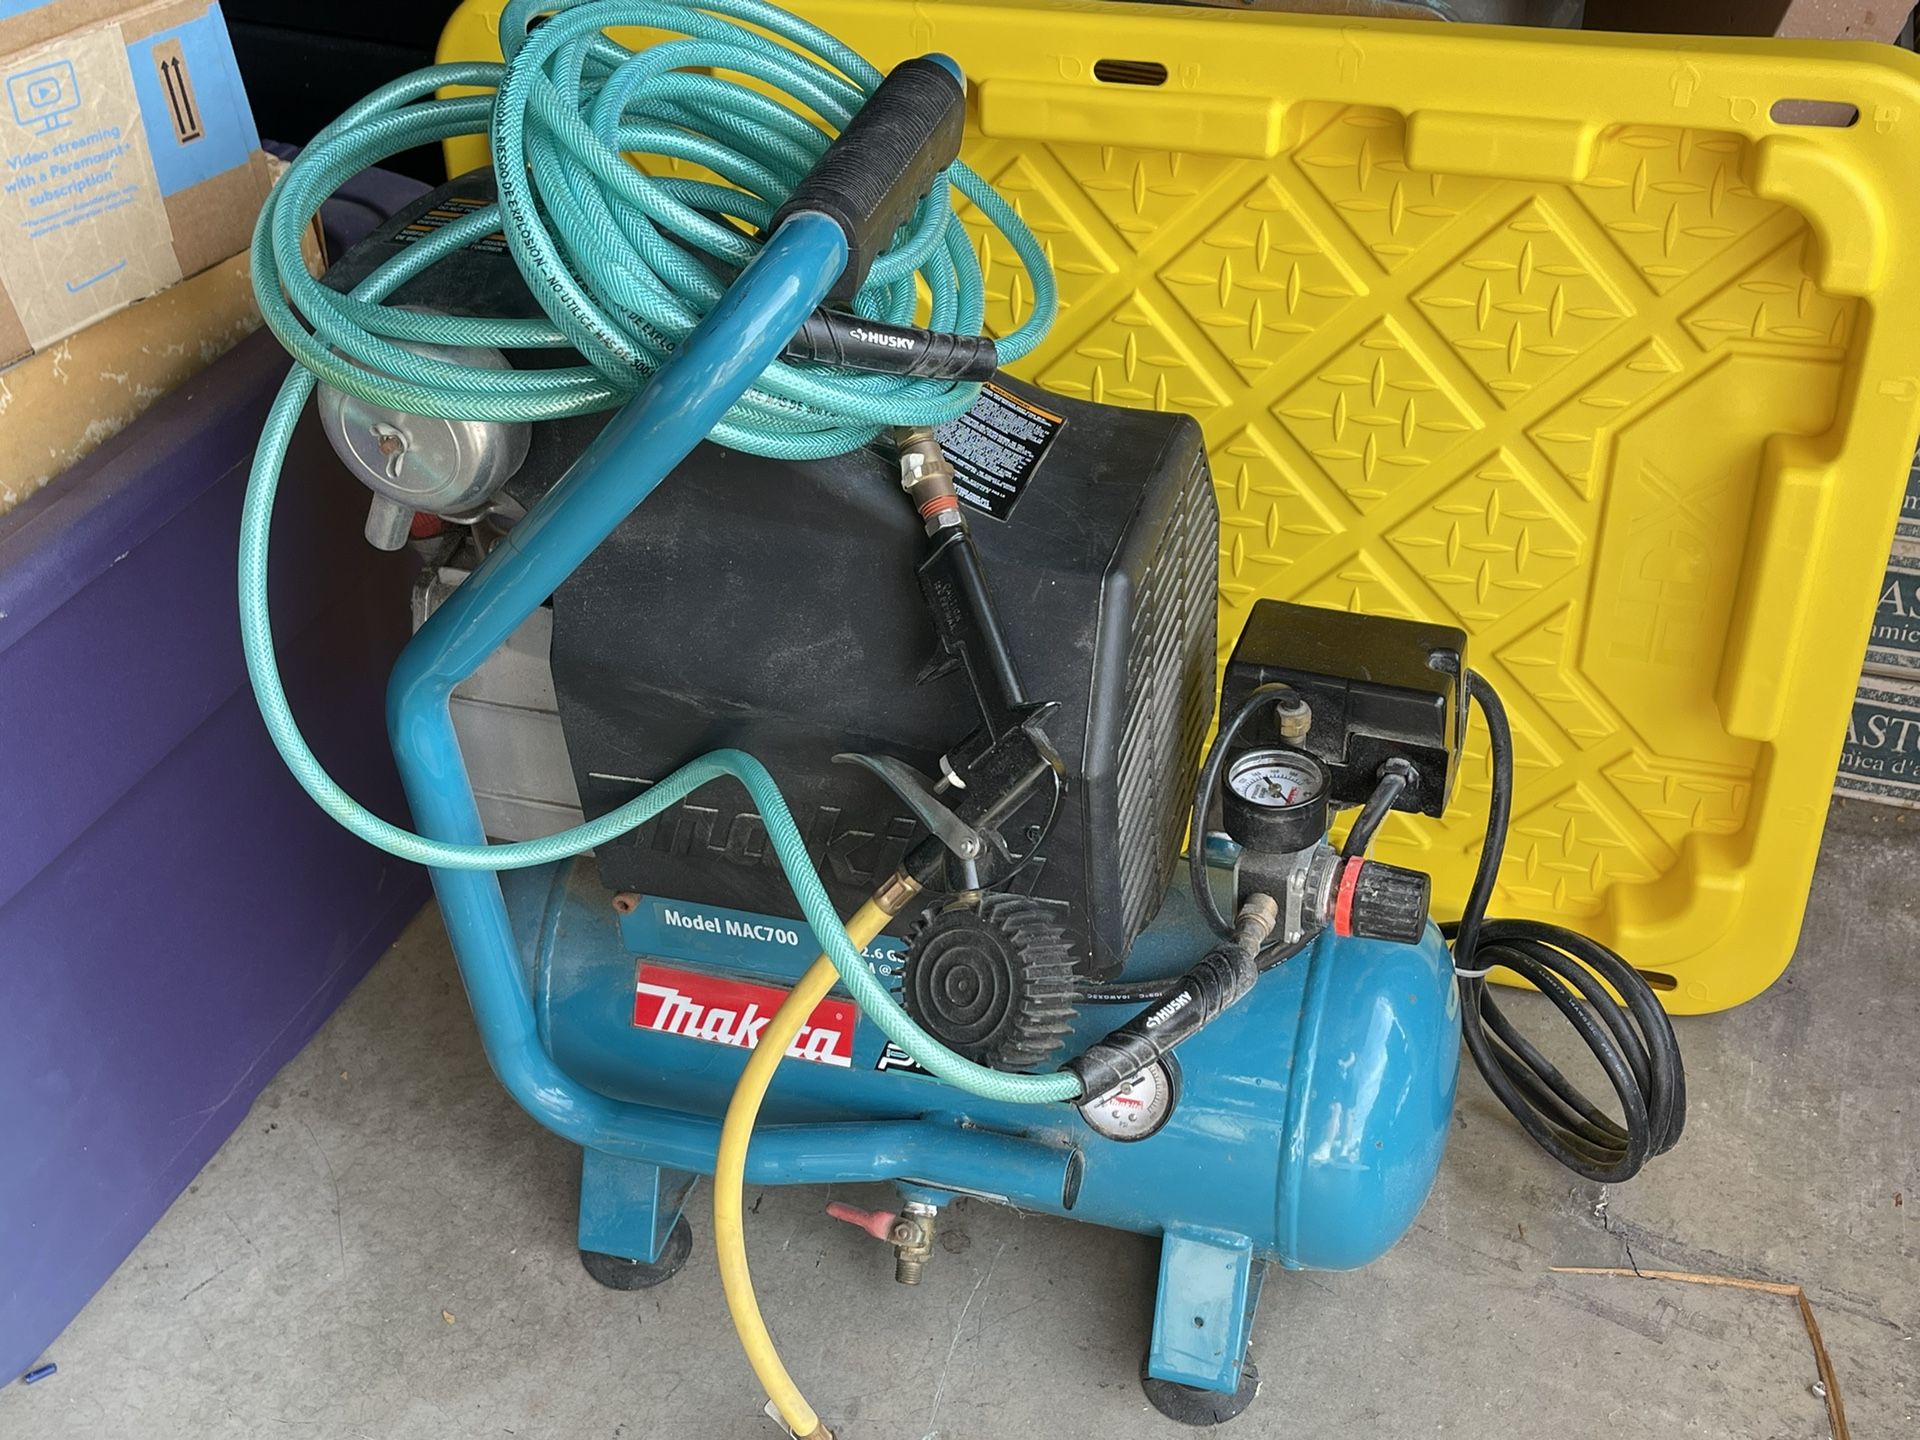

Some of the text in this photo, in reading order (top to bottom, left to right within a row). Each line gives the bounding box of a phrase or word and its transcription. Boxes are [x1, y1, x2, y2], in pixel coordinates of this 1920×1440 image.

[6, 127, 120, 170] Video streaming
[5, 174, 36, 193] with
[502, 182, 514, 198] DE
[548, 276, 563, 293] NO
[561, 293, 595, 331] UTILICE
[628, 312, 642, 327] DE
[867, 333, 915, 350] HUSKY
[788, 399, 803, 412] DE
[664, 909, 799, 946] Model MAC700
[861, 946, 884, 960] 2.6
[1158, 990, 1193, 1018] HUSKY
